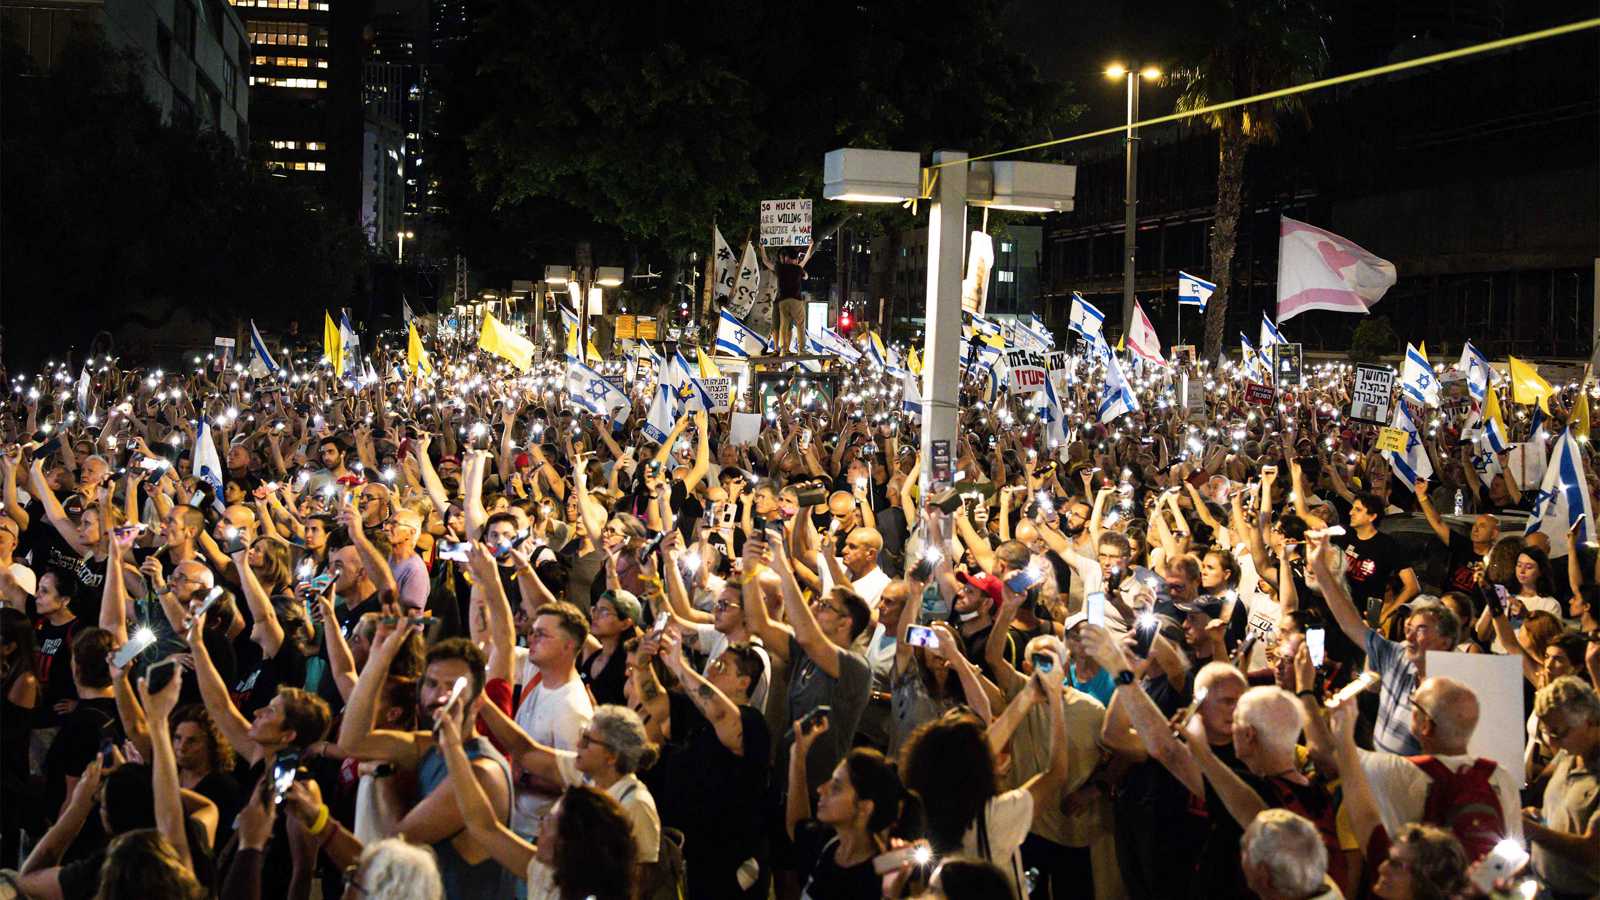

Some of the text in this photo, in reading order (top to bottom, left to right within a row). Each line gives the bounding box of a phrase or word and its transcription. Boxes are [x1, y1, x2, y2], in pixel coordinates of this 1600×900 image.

[762, 201, 811, 211] SO MUCH WE
[1359, 369, 1391, 383] החושך
[1360, 381, 1388, 393] בקצה
[1354, 391, 1389, 406] המנהרה
